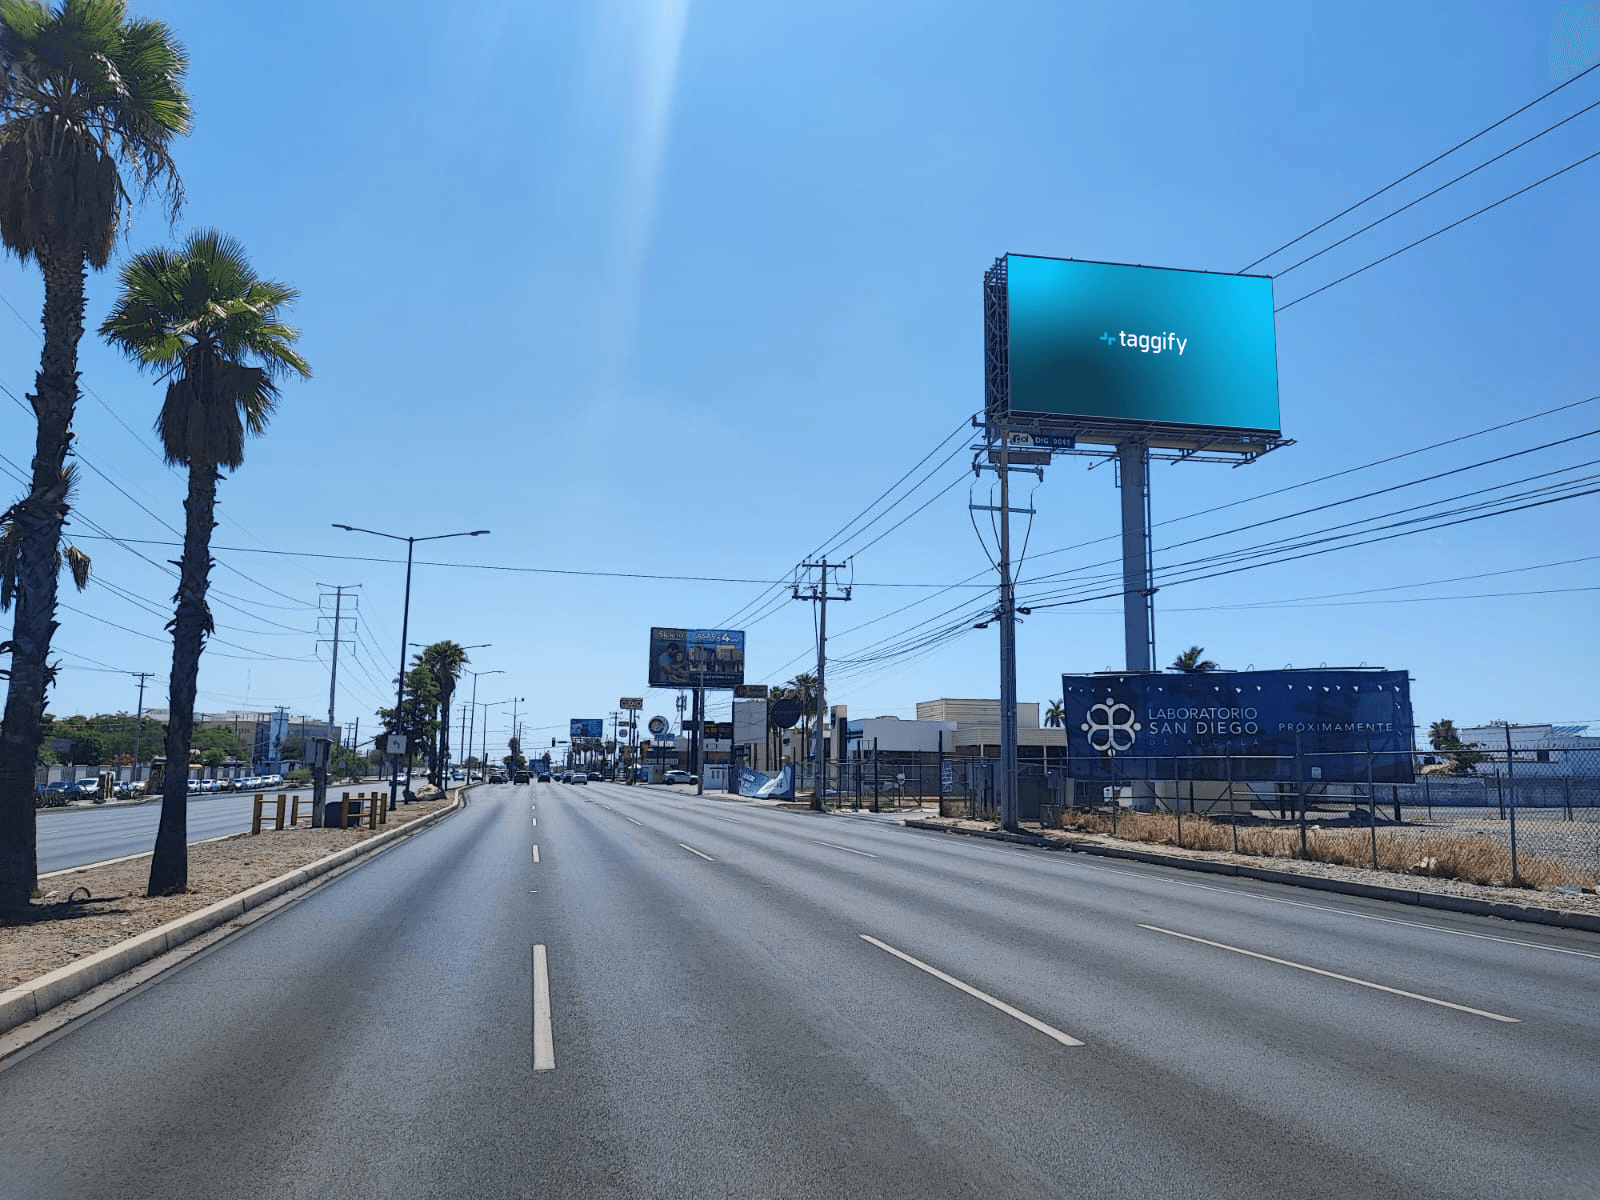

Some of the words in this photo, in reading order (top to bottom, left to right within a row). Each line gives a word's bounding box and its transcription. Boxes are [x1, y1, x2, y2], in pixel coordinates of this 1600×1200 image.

[1119, 331, 1187, 355] taggify
[1148, 707, 1258, 720] LABORATORIO
[1149, 721, 1187, 735] SAN
[1196, 721, 1258, 735] DIEGO
